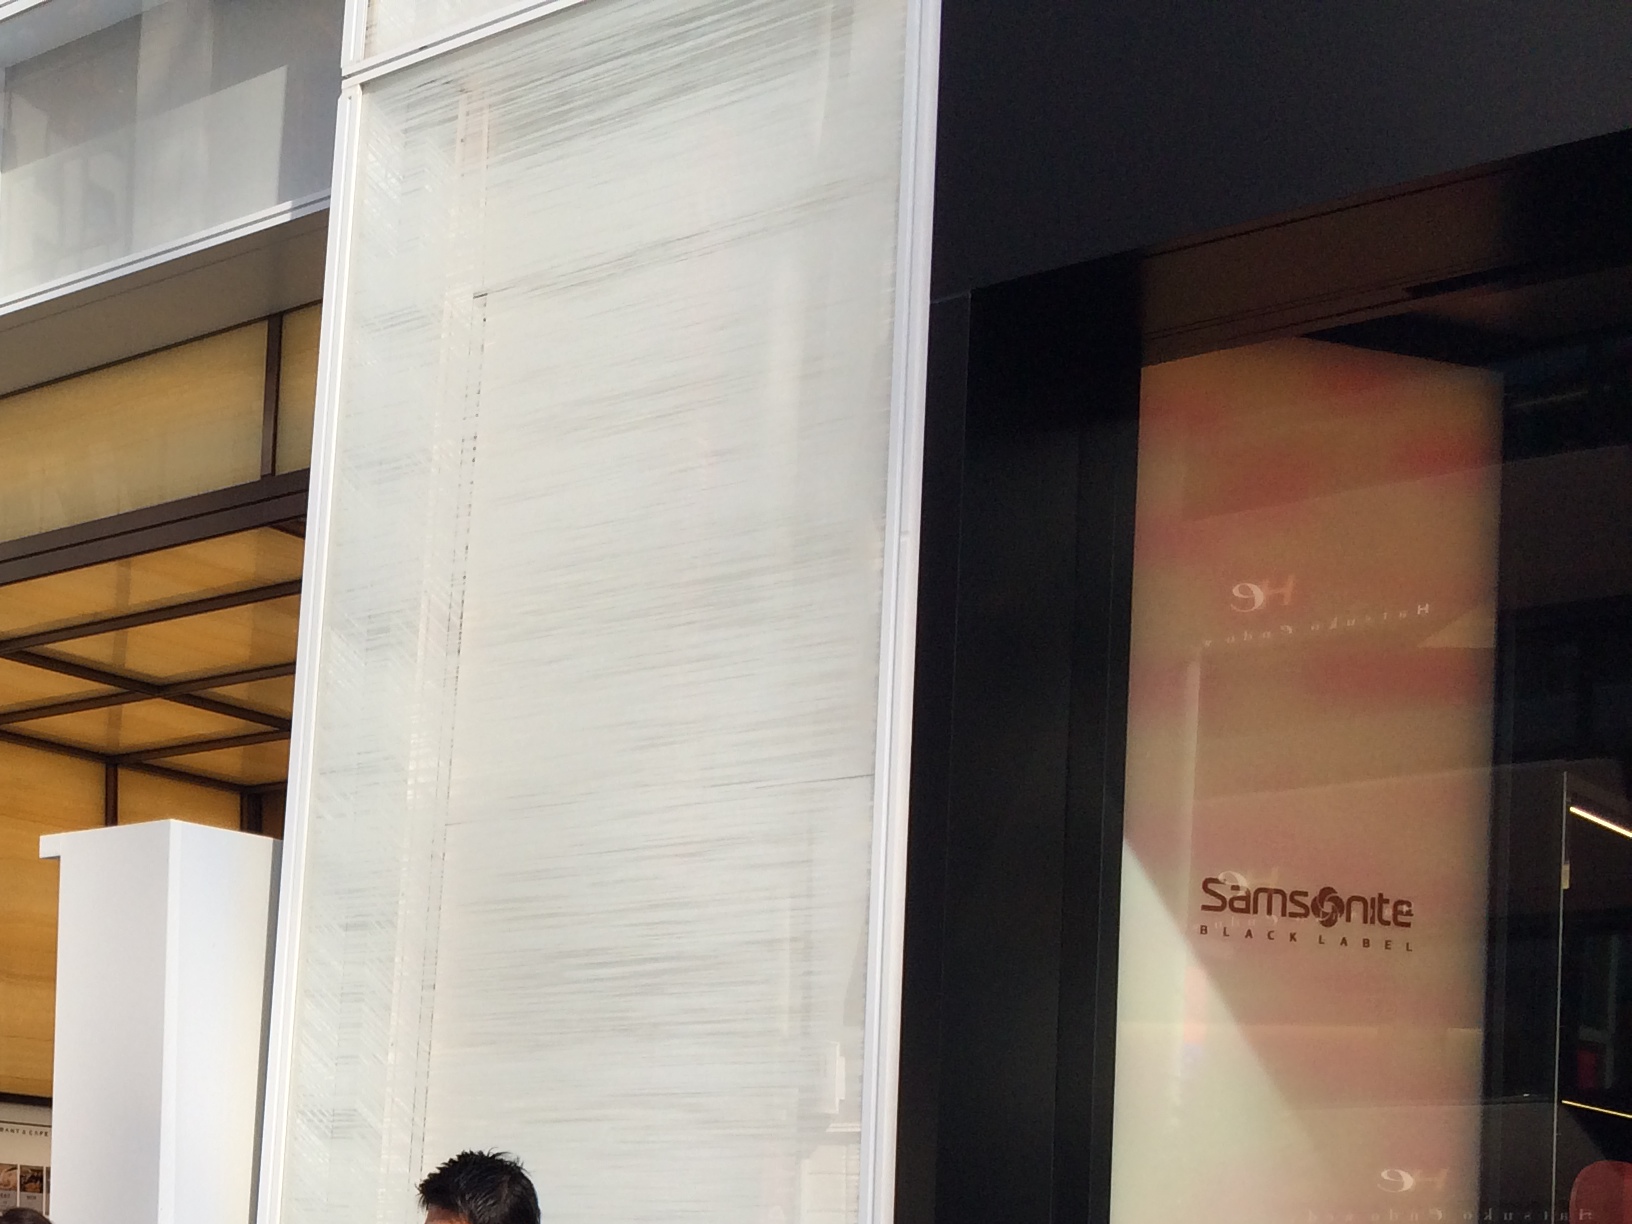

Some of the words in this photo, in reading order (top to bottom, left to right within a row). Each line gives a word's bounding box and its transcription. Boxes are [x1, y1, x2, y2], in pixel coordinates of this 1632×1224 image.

[1200, 877, 1414, 928] Samsonite
[1199, 924, 1298, 943] BLACK
[1317, 934, 1413, 952] LABEL
